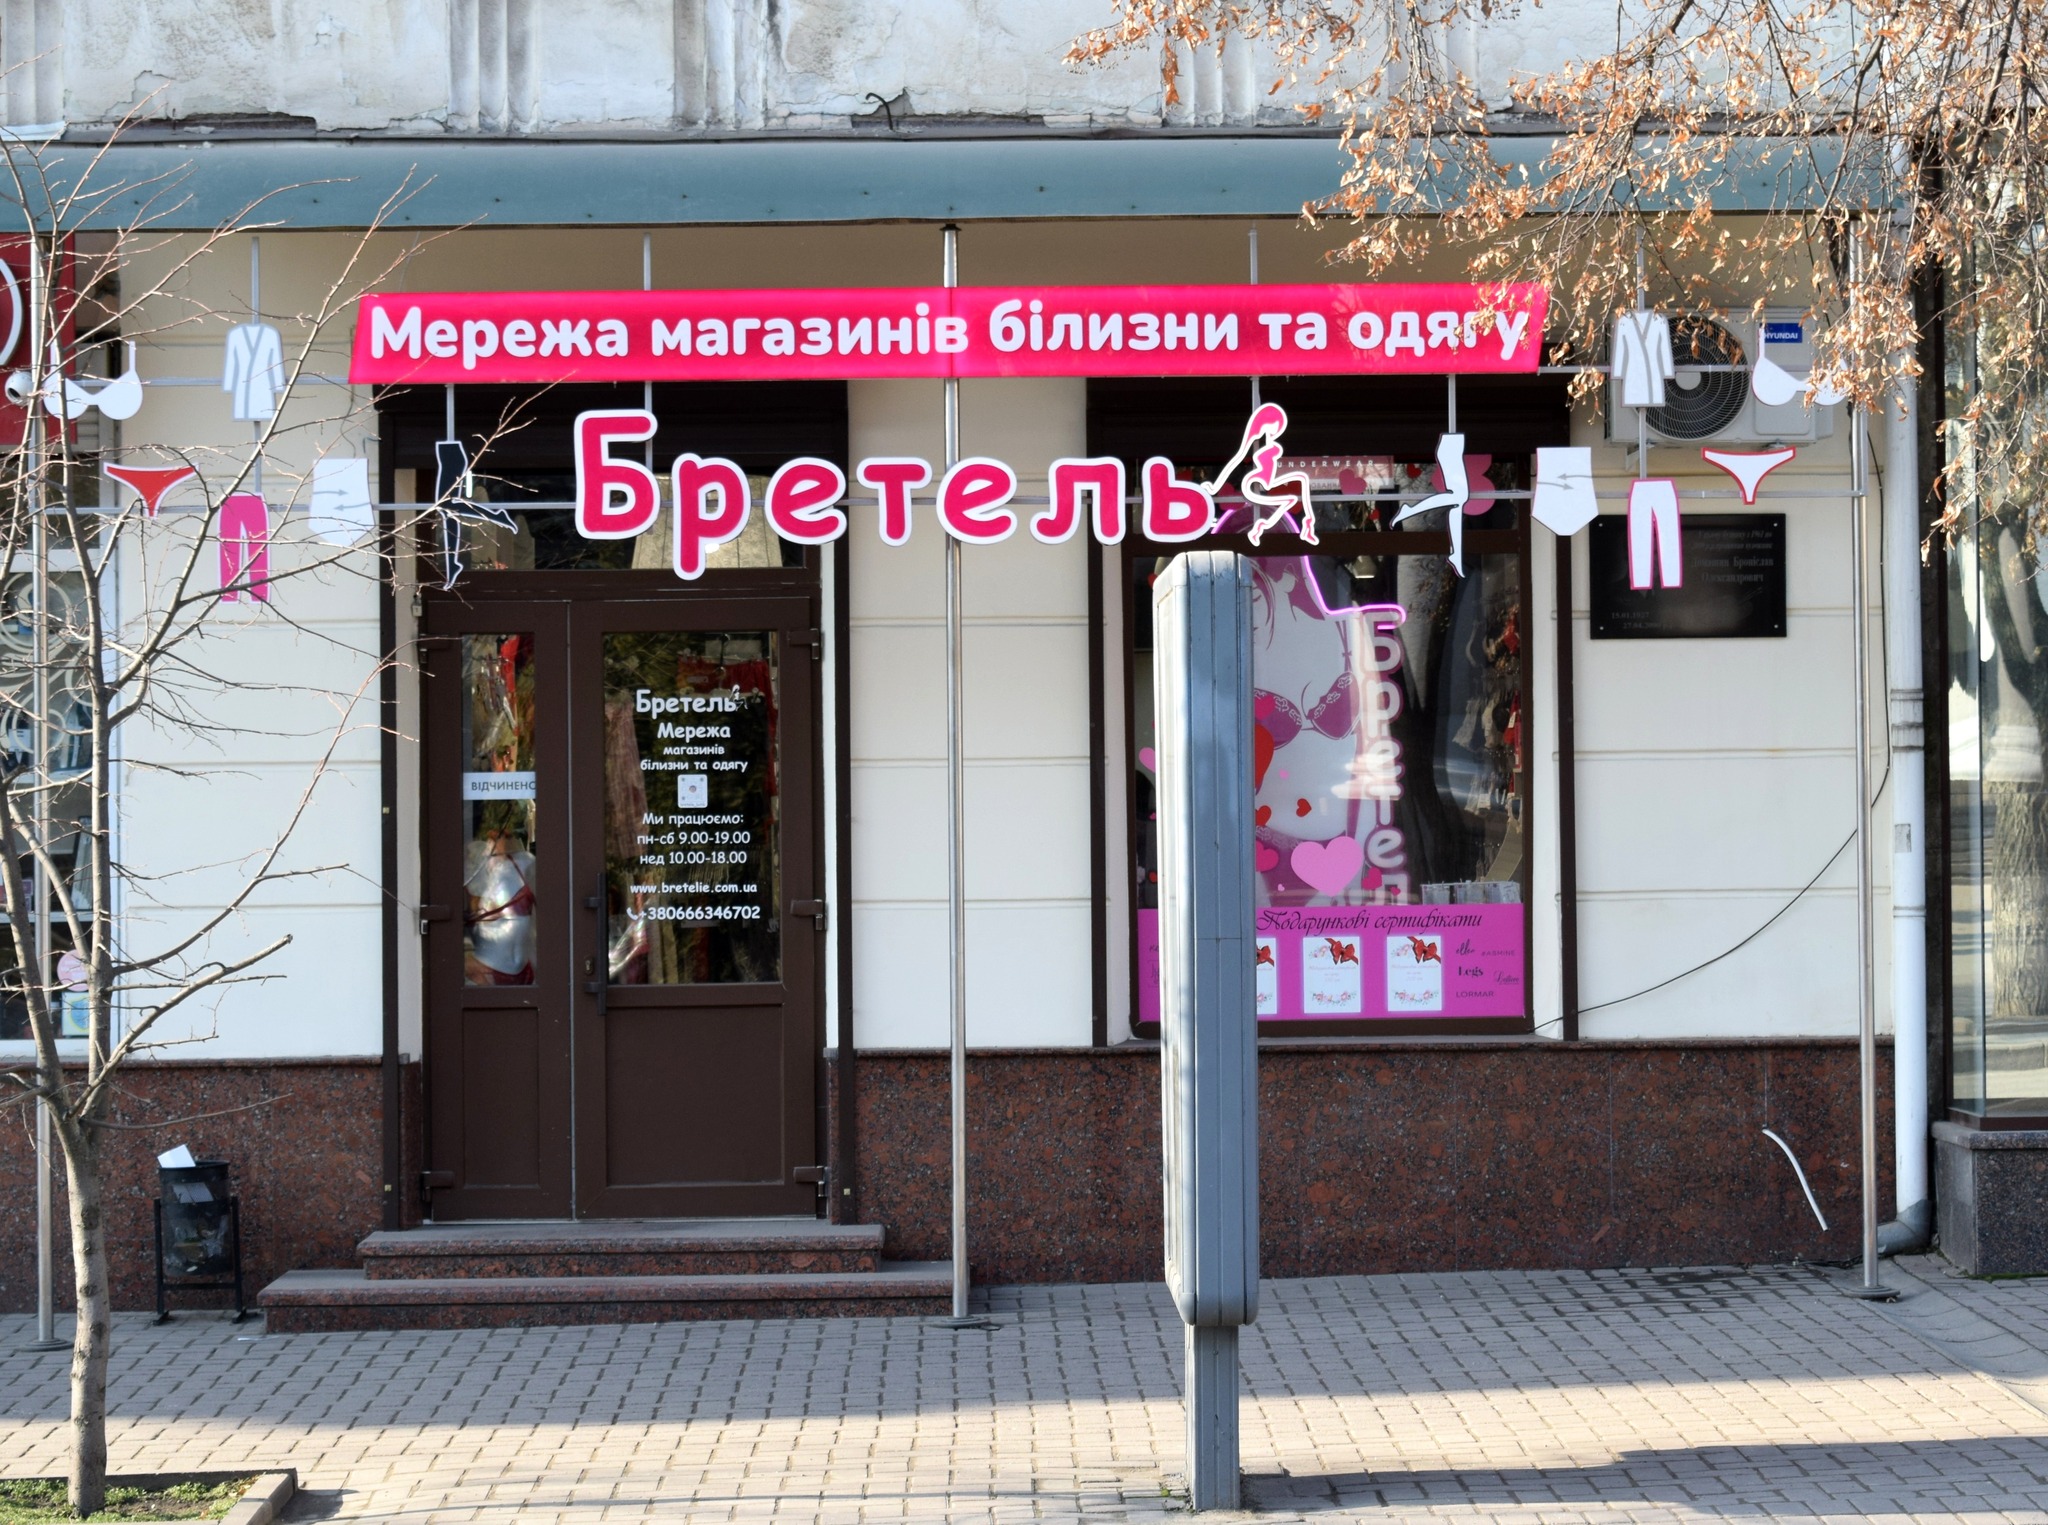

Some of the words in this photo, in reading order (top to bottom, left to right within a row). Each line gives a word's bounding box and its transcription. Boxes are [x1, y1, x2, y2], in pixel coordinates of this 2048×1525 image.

[370, 305, 629, 370] Мережа
[651, 302, 969, 357] магазинів
[988, 299, 1239, 352] білизни
[1258, 312, 1327, 350] та
[1347, 311, 1530, 360] одягу
[1764, 332, 1798, 340] HYUNDAI
[1277, 460, 1374, 468] UNDERWEAR
[573, 409, 1219, 581] Бретель
[636, 689, 737, 719] Бретель
[657, 722, 731, 742] Мережа
[663, 744, 725, 755] магазинів
[640, 760, 689, 771] білизни
[694, 762, 708, 771] та
[712, 762, 748, 773] одягу
[642, 813, 664, 825] Ми
[669, 813, 744, 828] працюємо:
[637, 833, 675, 845] пн-сб
[679, 831, 751, 845] 9.00-19.00
[640, 853, 665, 865] нед
[669, 851, 747, 864] 10.00-18.00
[630, 880, 757, 894] www.bretelie.com.ua
[640, 906, 760, 920] +380666346702
[1256, 909, 1370, 936] Подарункові
[1374, 908, 1482, 935] сертифікати
